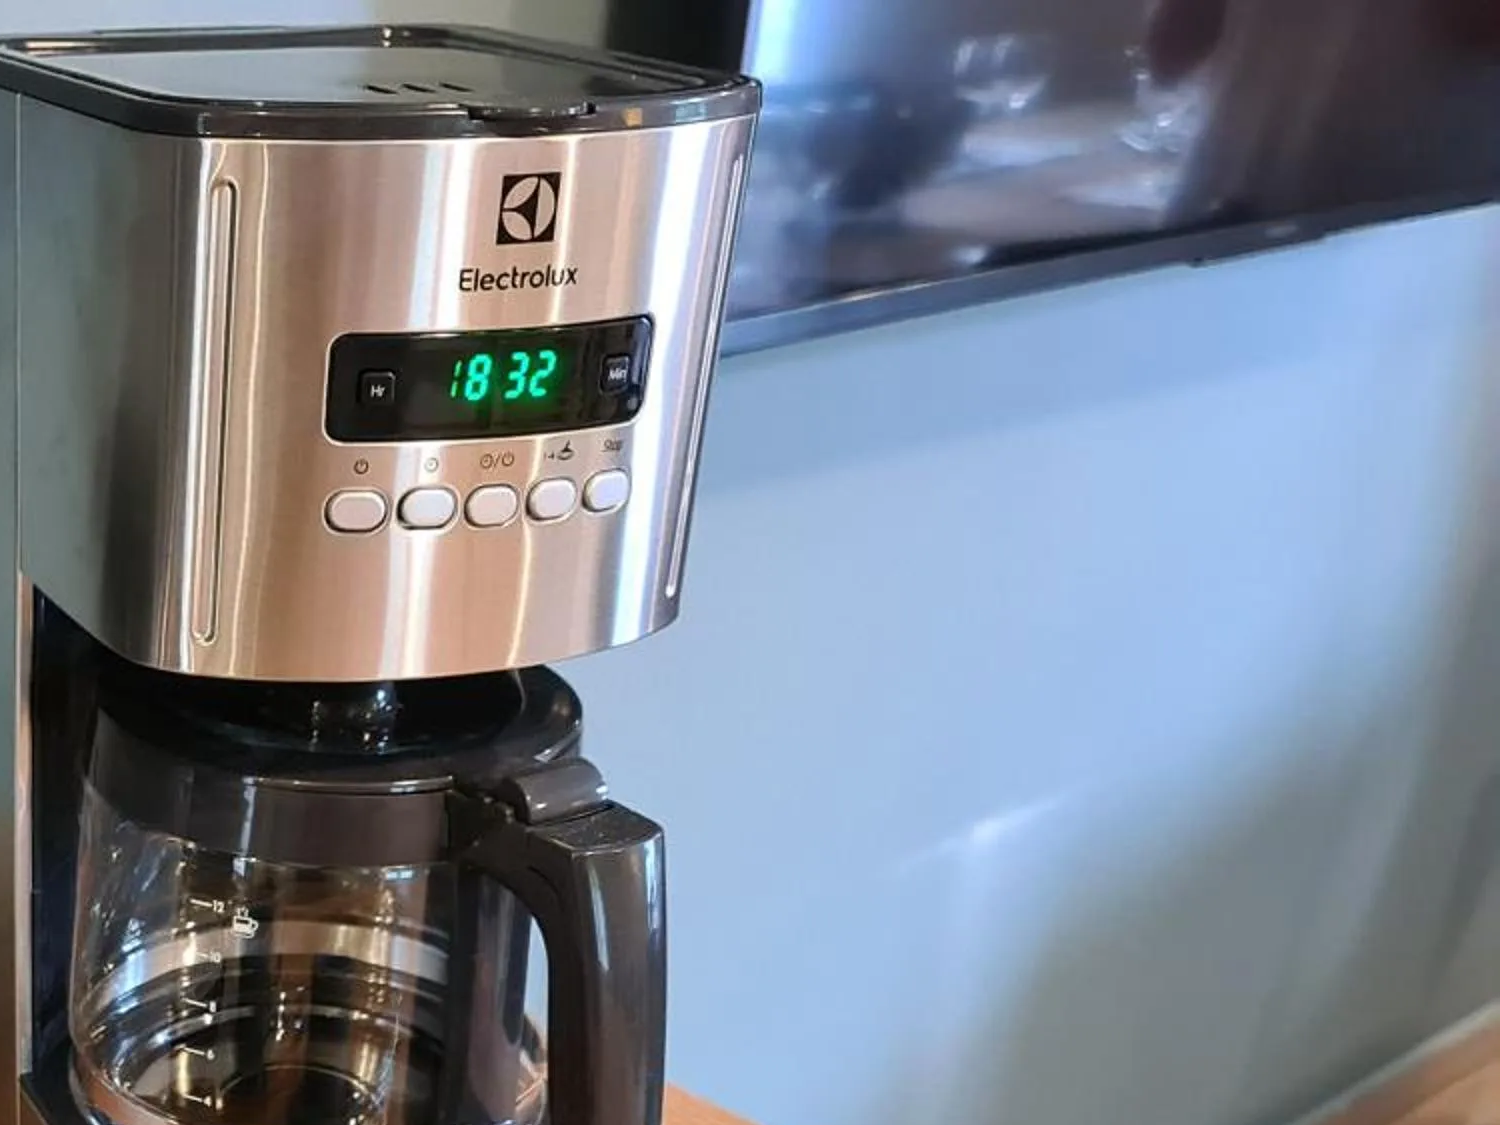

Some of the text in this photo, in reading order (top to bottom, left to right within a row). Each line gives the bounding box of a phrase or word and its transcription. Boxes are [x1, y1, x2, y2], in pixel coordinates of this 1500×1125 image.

[458, 264, 578, 292] Electrolux
[370, 384, 386, 398] Hr
[213, 899, 225, 913] 12
